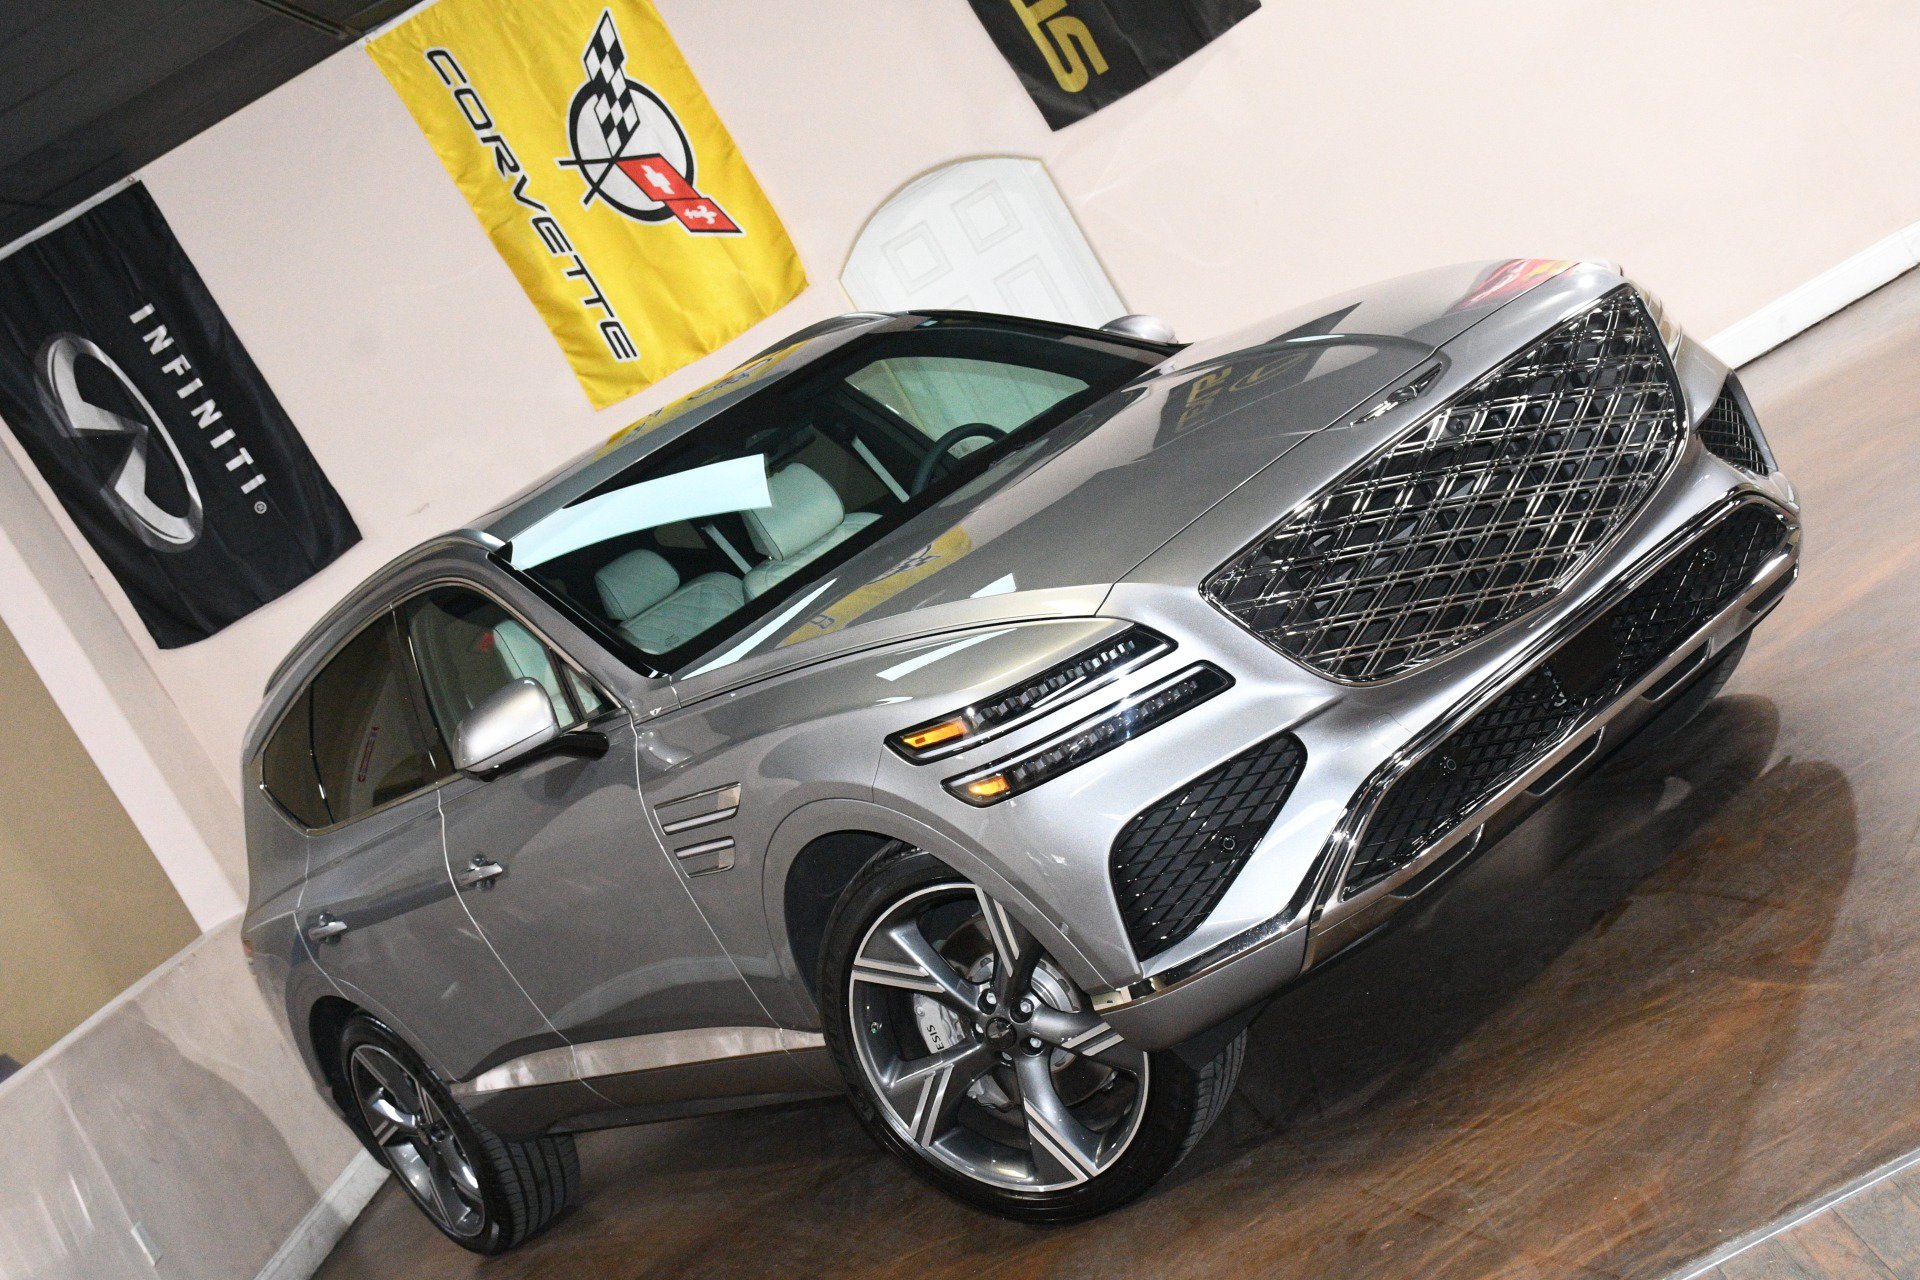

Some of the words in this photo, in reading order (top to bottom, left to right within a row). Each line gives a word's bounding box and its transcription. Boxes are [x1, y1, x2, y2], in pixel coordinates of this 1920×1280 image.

[425, 48, 638, 360] CORVETTE
[129, 303, 267, 495] INFINITI
[926, 1025, 944, 1050] ESIS
